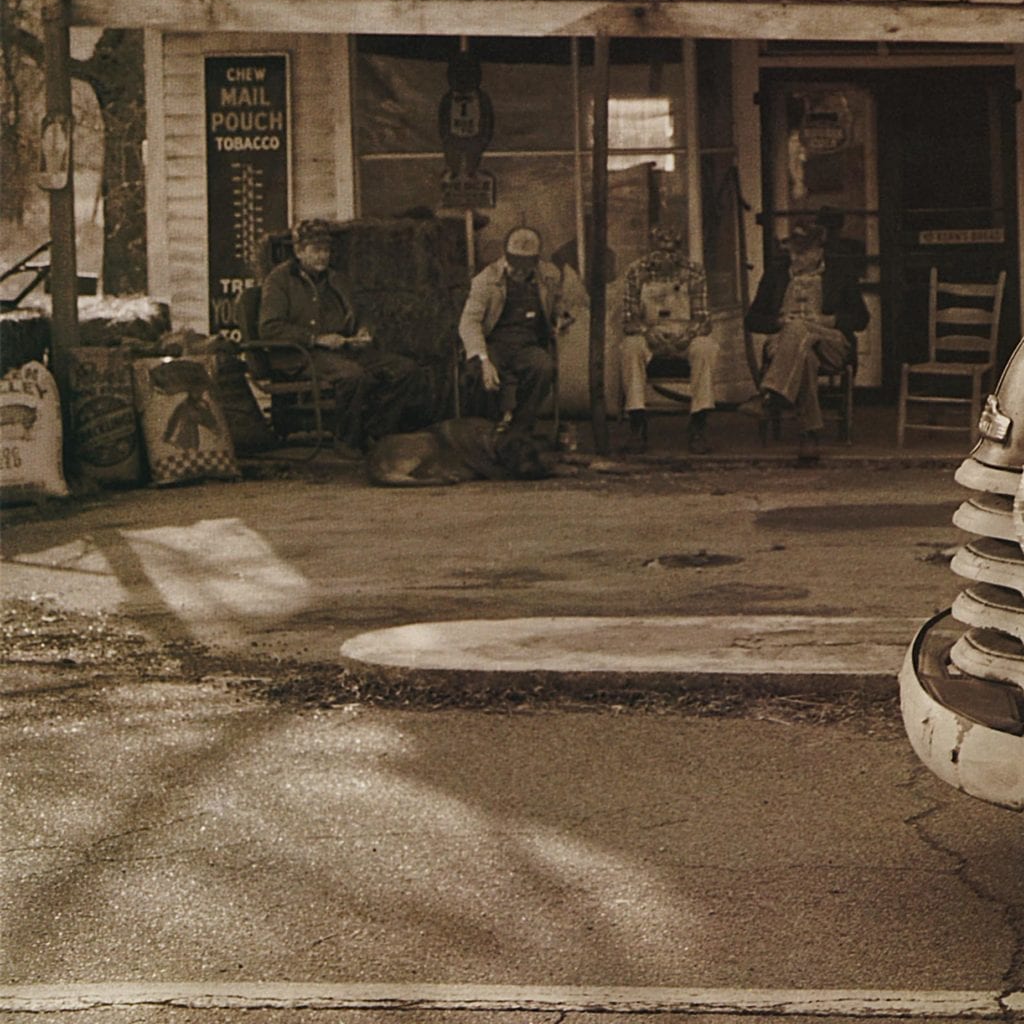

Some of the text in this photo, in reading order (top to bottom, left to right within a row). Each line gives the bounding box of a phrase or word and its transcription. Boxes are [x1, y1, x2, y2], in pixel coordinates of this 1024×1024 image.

[226, 67, 266, 82] CHEW
[220, 86, 271, 107] MAIL
[211, 110, 283, 132] POUCH
[215, 136, 280, 151] TOBACCO
[0, 380, 47, 399] LEY
